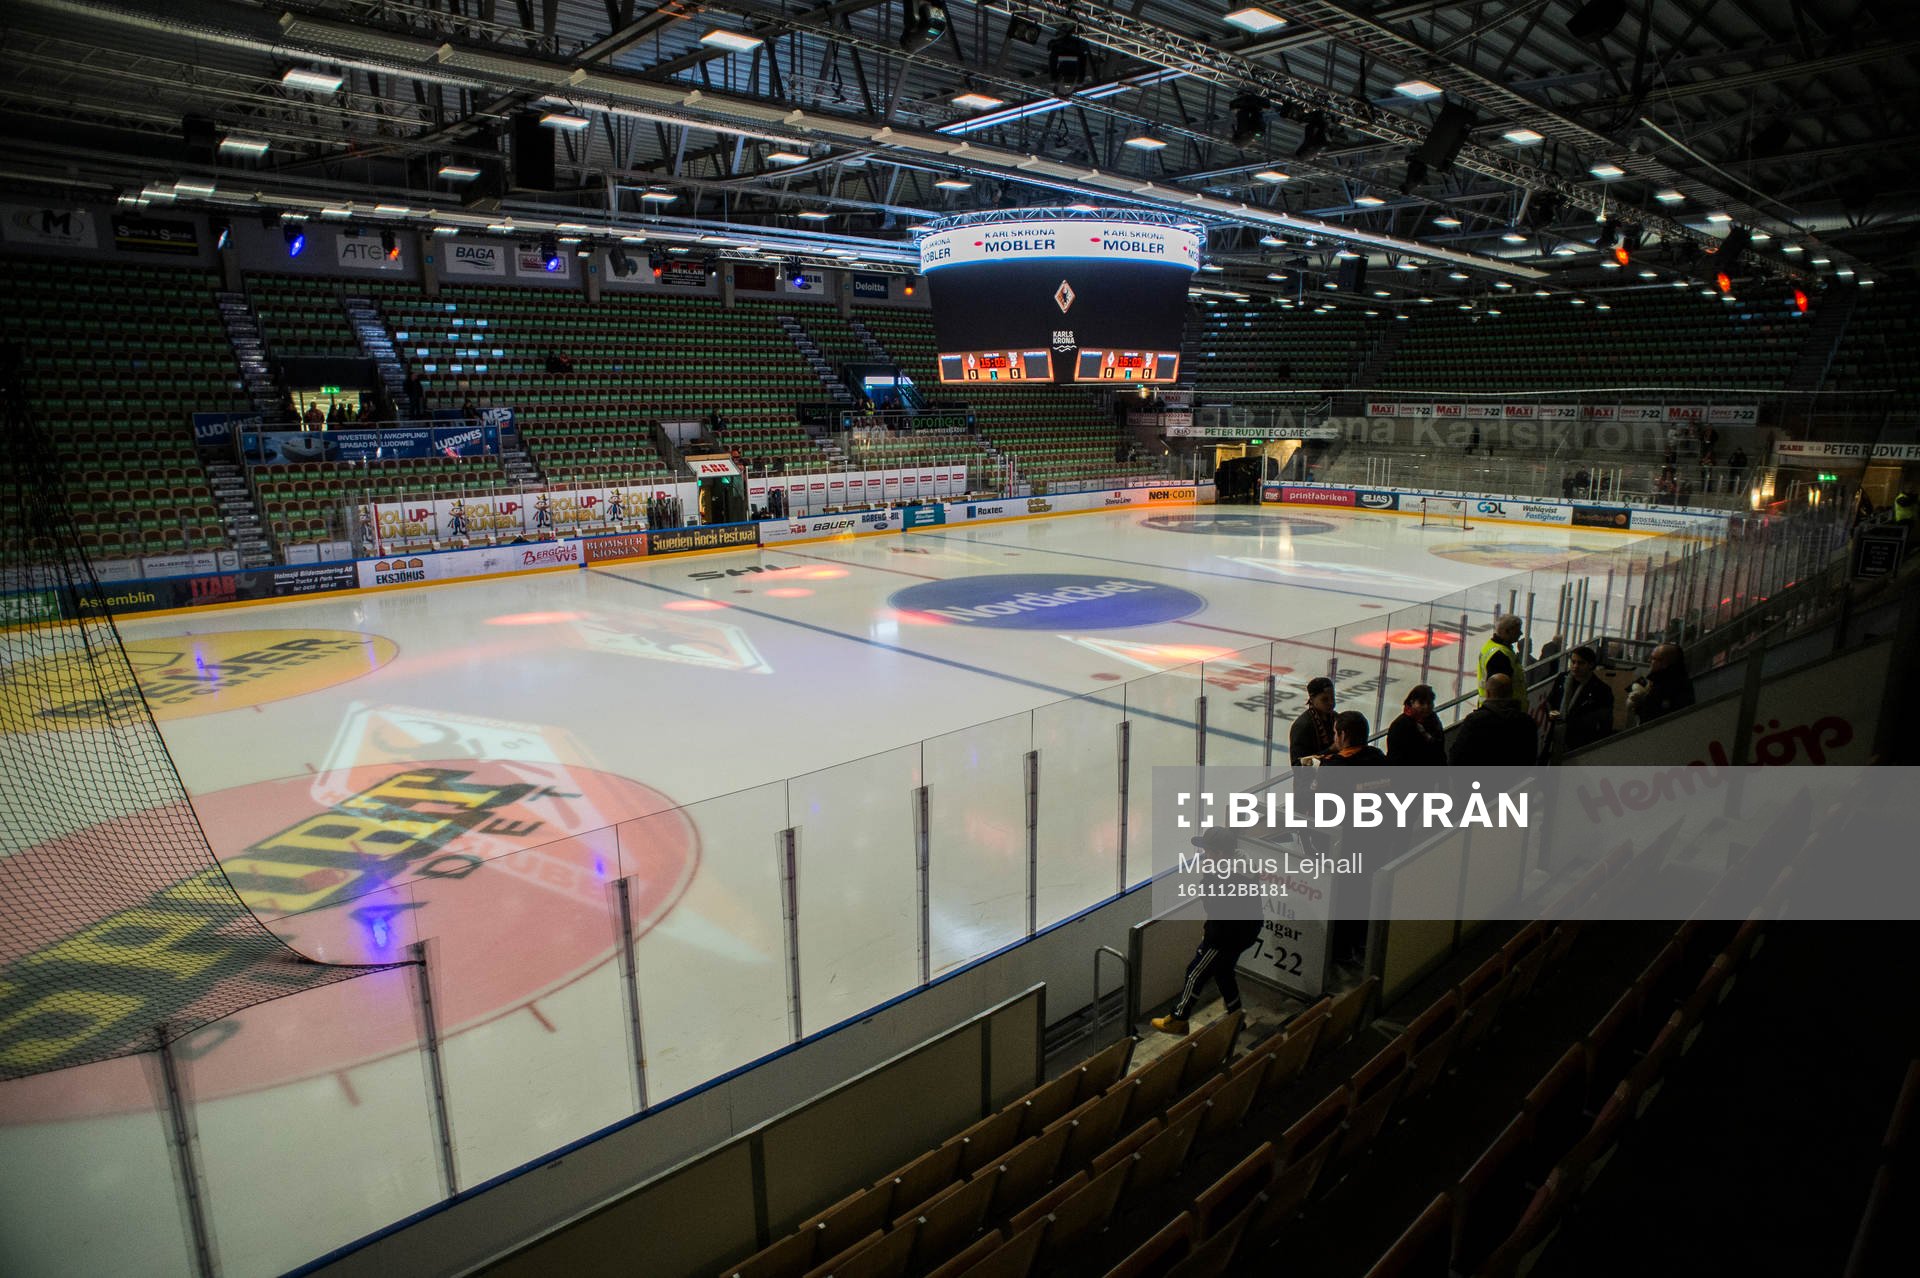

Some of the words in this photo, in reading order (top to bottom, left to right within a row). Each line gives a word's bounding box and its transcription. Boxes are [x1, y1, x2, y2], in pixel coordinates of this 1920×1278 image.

[455, 246, 495, 260] BAGA
[1052, 330, 1073, 338] KARLS
[1416, 407, 1430, 415] 7-22
[1484, 408, 1500, 416] 7-22
[1558, 408, 1575, 417] 7-22
[1641, 409, 1660, 418] 7-22
[1733, 410, 1754, 419] 7-22
[1204, 427, 1233, 437] PETER
[1268, 429, 1311, 438] ECO-MEC
[1412, 416, 1668, 453] Karlskron
[435, 428, 482, 449] LUDDWES
[1823, 444, 1860, 455] PETER
[700, 463, 730, 474] ABB
[1289, 491, 1348, 502] printfabriken
[977, 506, 1003, 515] Roxtec
[586, 536, 643, 550] BLOMSTER
[653, 532, 693, 551] Sweden
[693, 529, 718, 547] Rock
[718, 526, 756, 544] Festival
[592, 546, 639, 559] KIOSKEN
[78, 591, 156, 609] Assemblin
[1577, 716, 1853, 824] Hemköp
[1265, 919, 1303, 942] agar
[1252, 937, 1304, 977] 7-22
